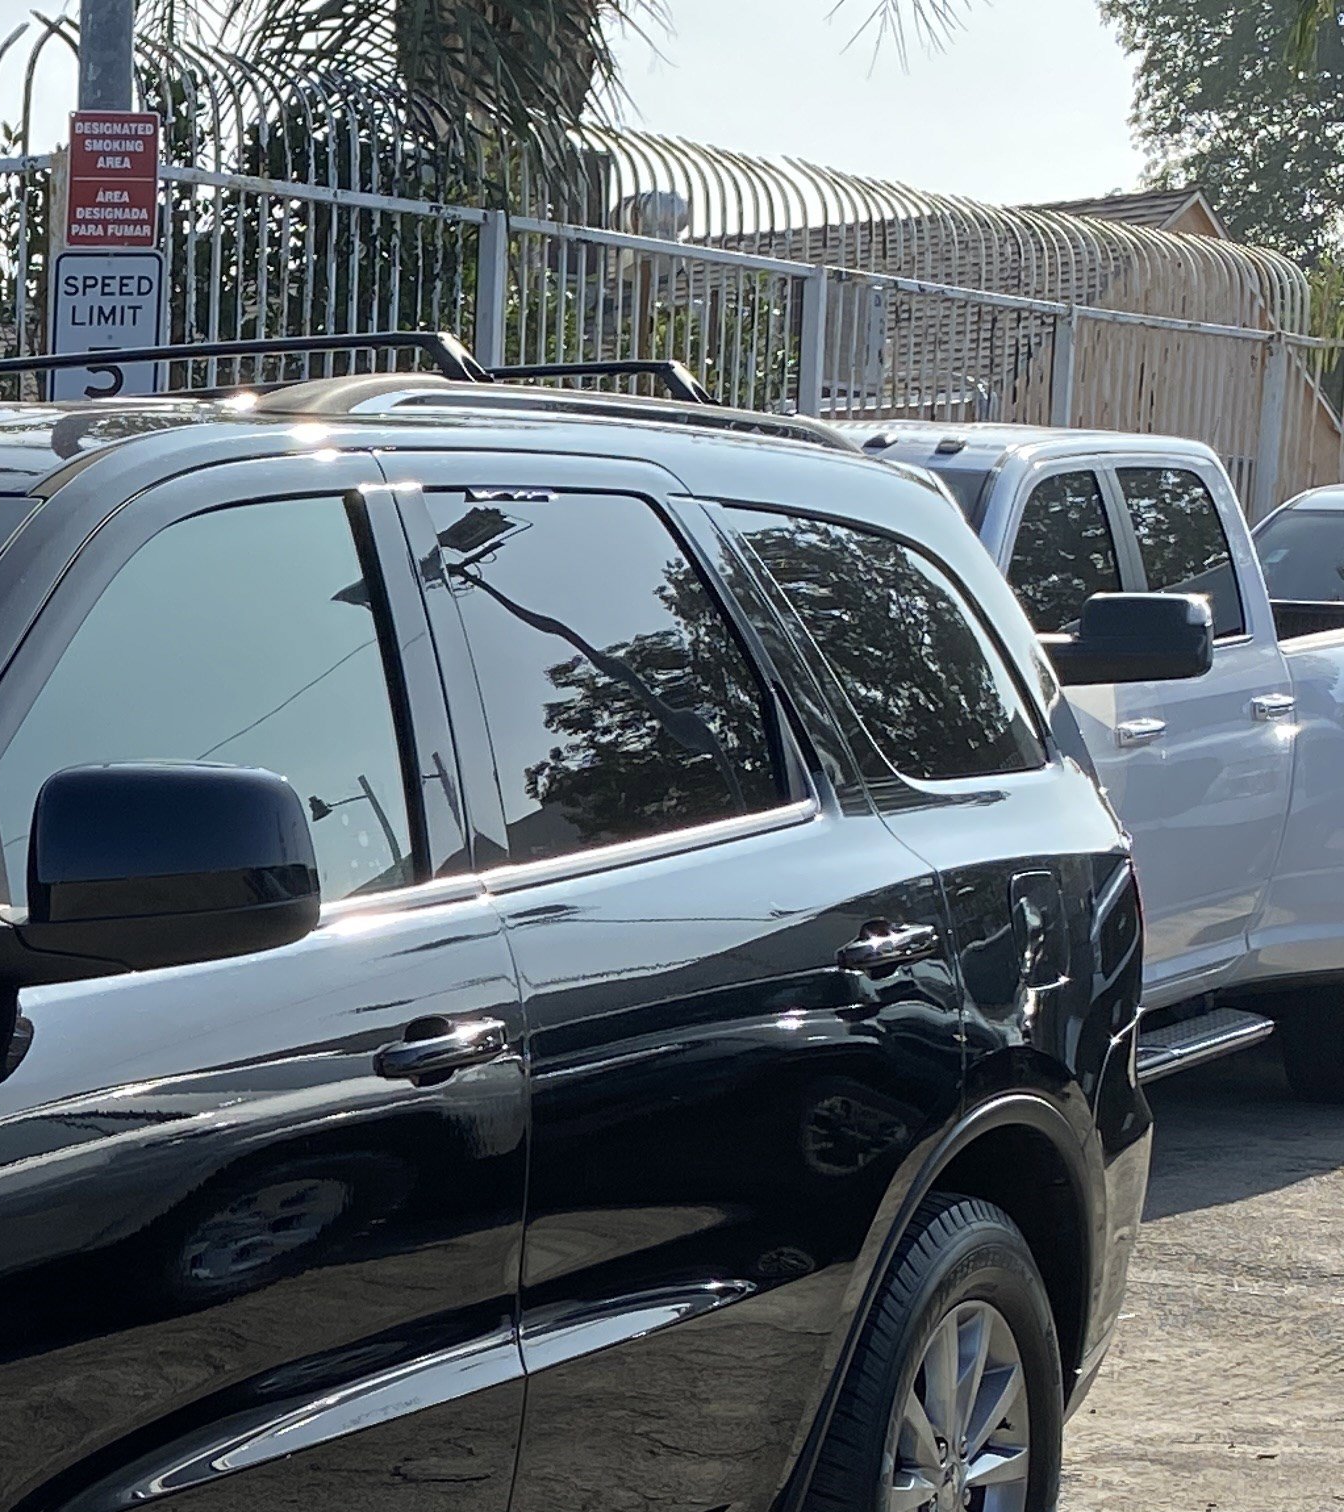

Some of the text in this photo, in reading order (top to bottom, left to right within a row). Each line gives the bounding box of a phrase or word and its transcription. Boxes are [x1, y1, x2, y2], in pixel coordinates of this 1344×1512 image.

[74, 121, 154, 136] DESIGNATED
[84, 139, 144, 153] SMOKING
[96, 156, 132, 170] AREA
[76, 207, 148, 221] DESIGNADA
[71, 224, 151, 238] PARA FUMAR
[64, 275, 153, 297] SPEED
[71, 304, 143, 327] LIMIT
